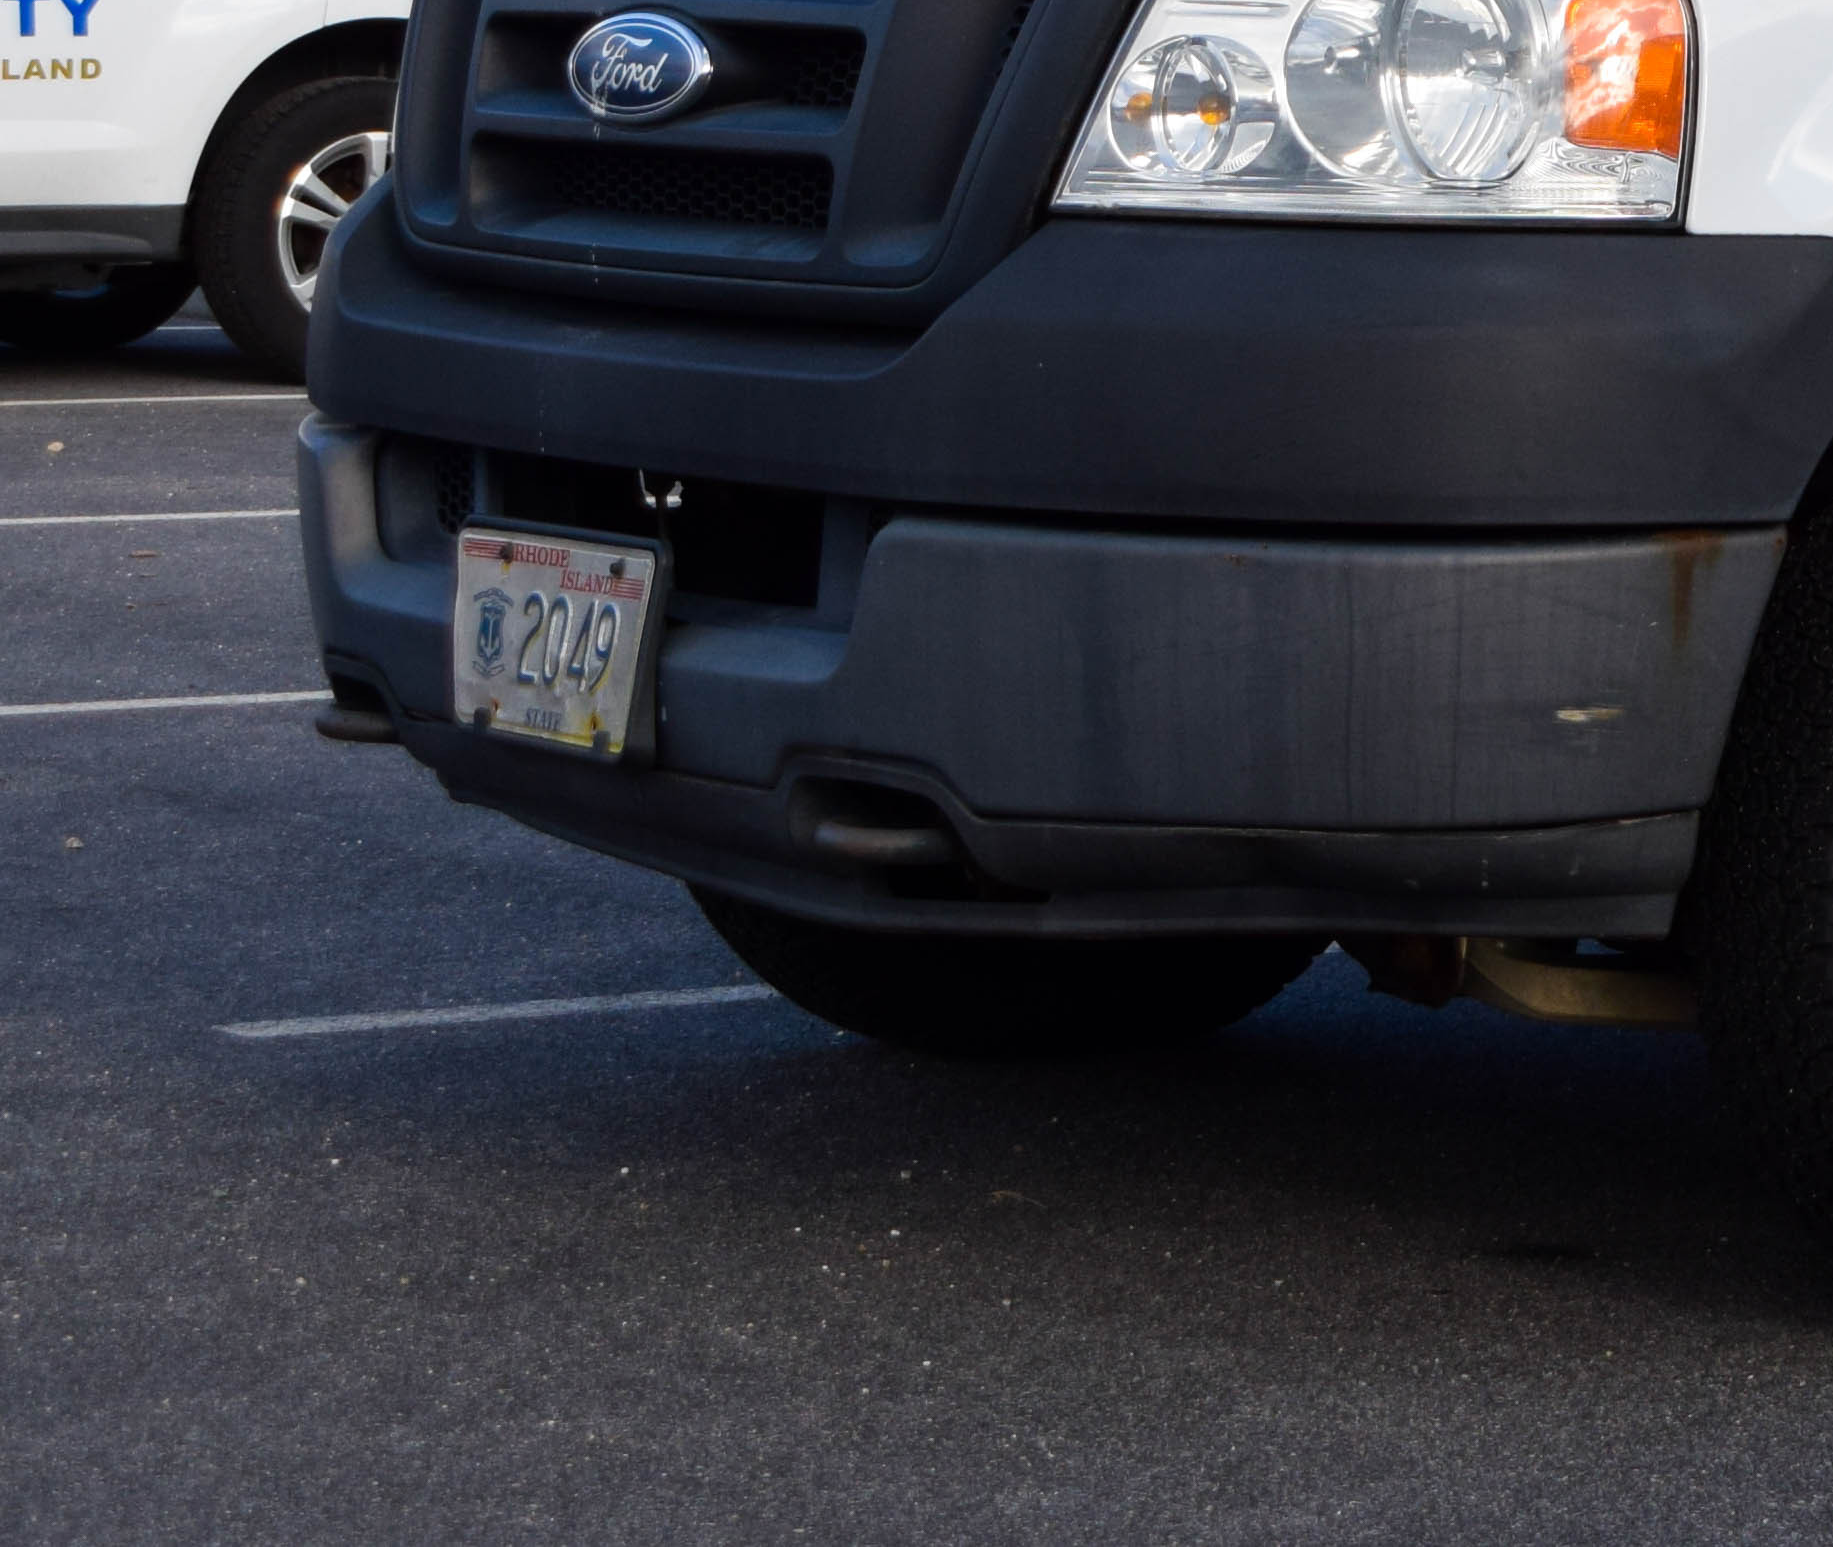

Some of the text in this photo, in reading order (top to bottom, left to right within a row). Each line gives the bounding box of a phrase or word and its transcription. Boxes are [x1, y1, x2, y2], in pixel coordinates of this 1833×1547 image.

[591, 33, 669, 94] Ford
[513, 544, 570, 568] RHODE
[560, 569, 614, 594] ISLAND
[517, 591, 617, 695] 2049
